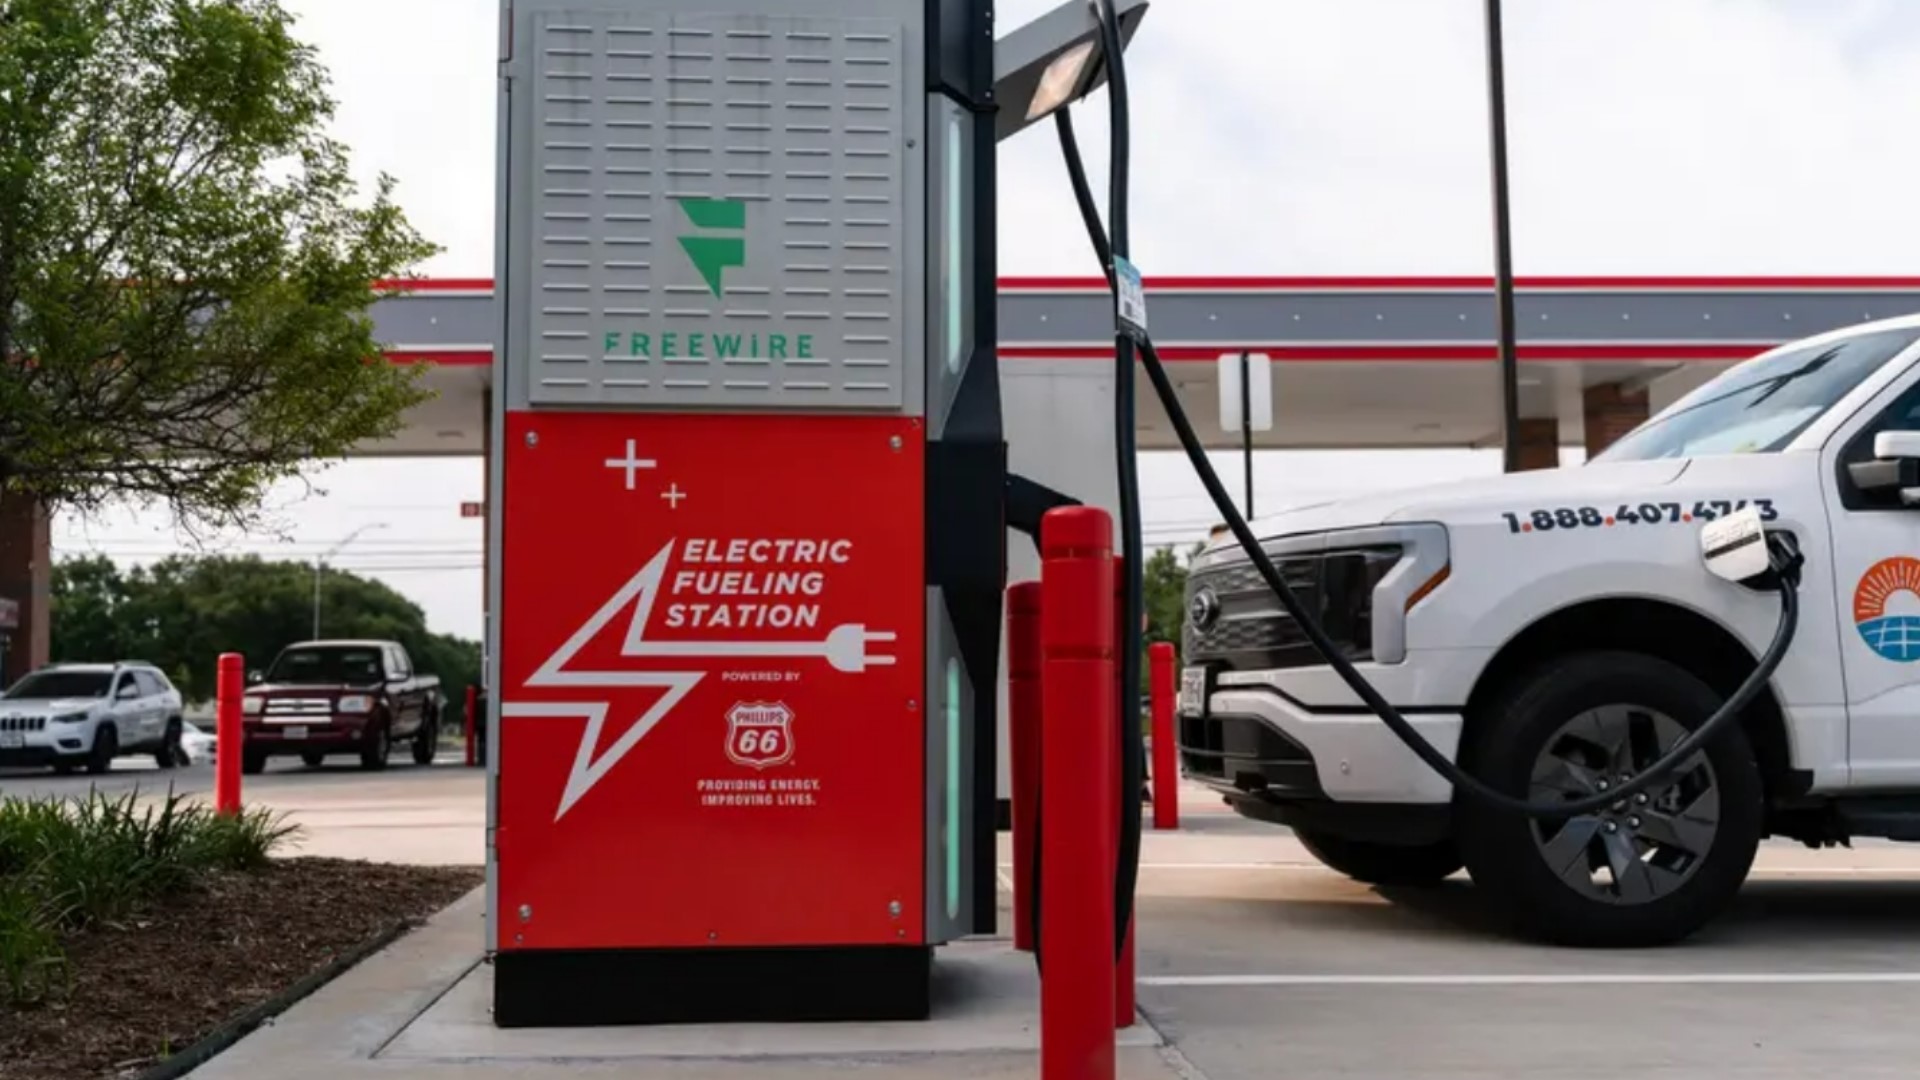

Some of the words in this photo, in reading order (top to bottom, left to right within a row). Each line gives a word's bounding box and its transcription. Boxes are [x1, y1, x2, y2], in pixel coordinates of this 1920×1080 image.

[682, 538, 853, 563] ELECTRIC
[672, 571, 825, 596] FUELING
[664, 603, 820, 628] STATION
[721, 670, 782, 682] POWERED
[784, 670, 801, 682] BY
[735, 711, 786, 724] PHILLIPS
[738, 728, 780, 754] 66
[697, 779, 767, 791] PROVIDING
[770, 779, 821, 791] ENERGY.
[701, 794, 773, 806] IMPROVING
[777, 794, 817, 806] LIVES.
